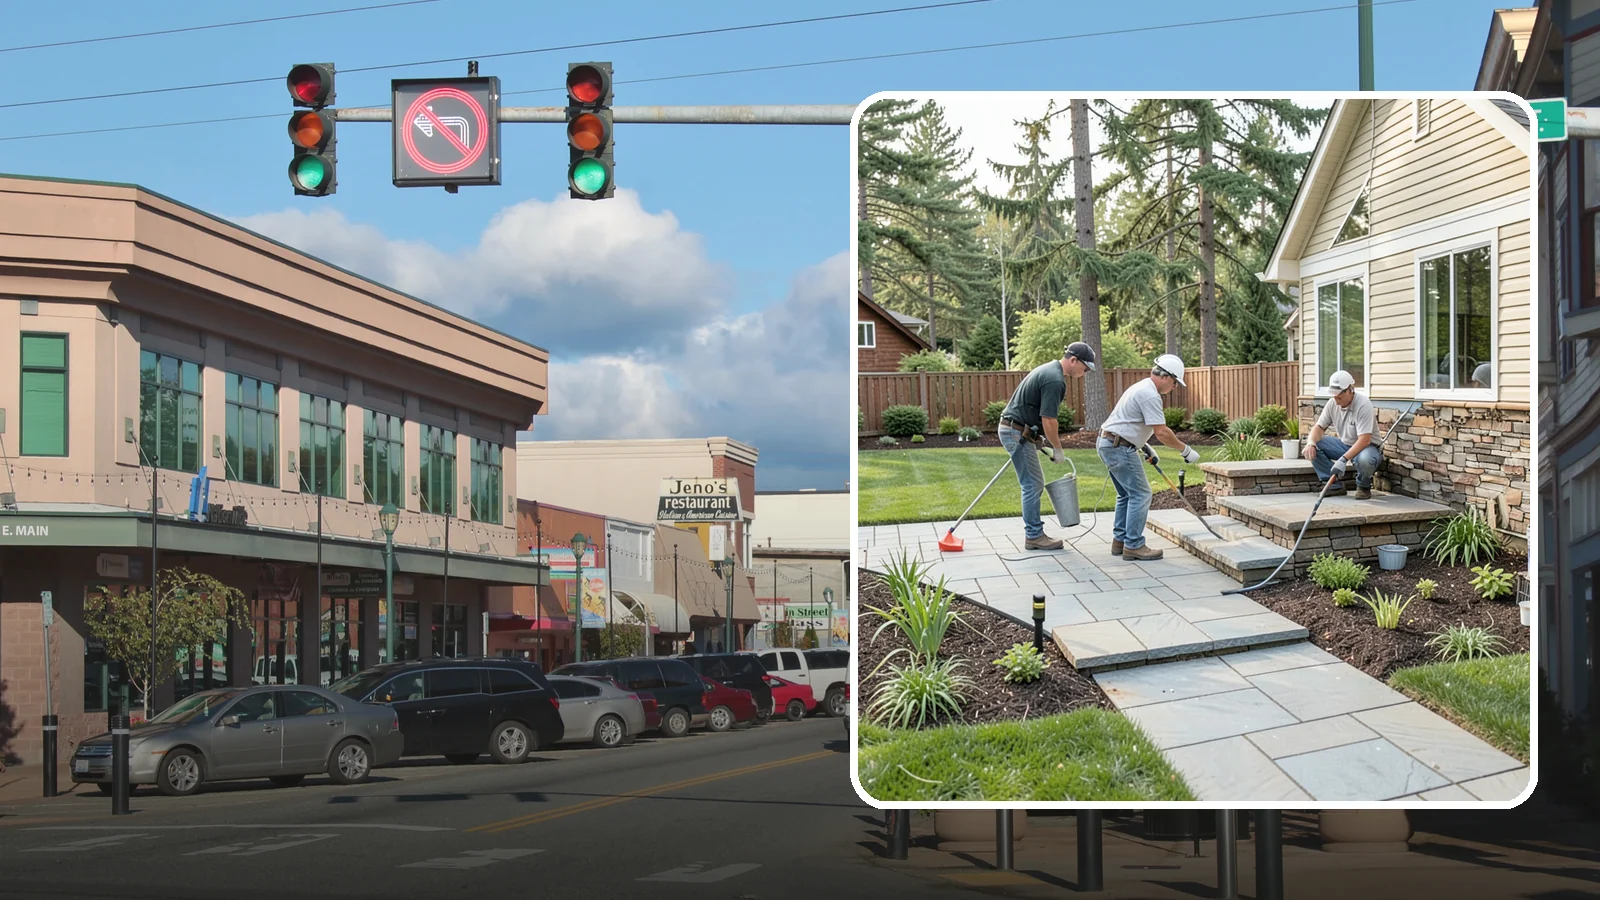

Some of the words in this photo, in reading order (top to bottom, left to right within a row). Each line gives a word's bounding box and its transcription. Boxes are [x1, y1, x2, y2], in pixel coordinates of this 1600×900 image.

[670, 480, 727, 494] Jeno's
[665, 496, 731, 509] restaurant
[658, 511, 682, 519] Italian
[686, 510, 714, 519] American
[715, 510, 738, 519] Cuisine
[2, 525, 13, 536] E.
[15, 525, 49, 536] MAIN
[797, 608, 828, 617] Street
